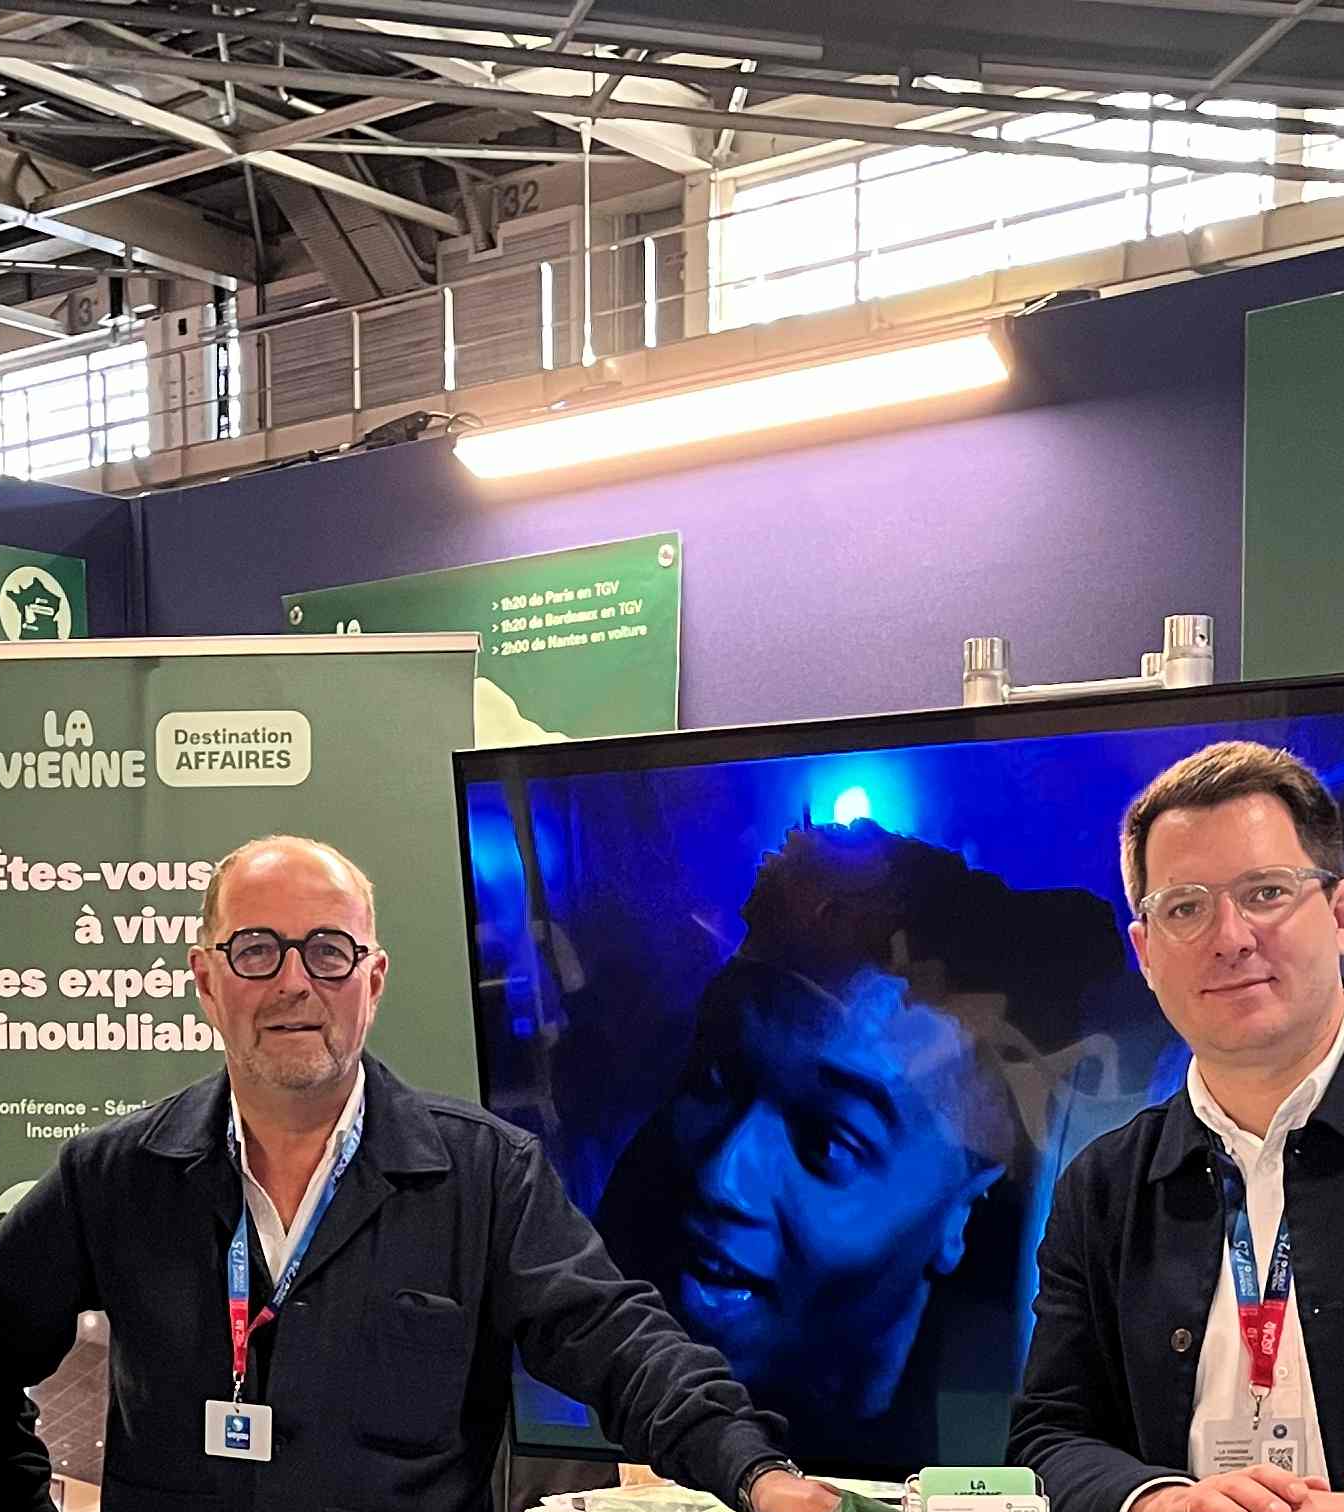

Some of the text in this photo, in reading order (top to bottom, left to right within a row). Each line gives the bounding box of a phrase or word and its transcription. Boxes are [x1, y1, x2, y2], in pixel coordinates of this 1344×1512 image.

[501, 594, 527, 611] 1h20
[529, 591, 544, 607] de
[545, 588, 574, 605] Paris
[577, 587, 592, 600] en
[594, 580, 620, 597] TGV
[501, 617, 527, 634] 1h20
[529, 615, 544, 630] de
[545, 607, 598, 626] Bordeaux
[601, 606, 616, 619] en
[618, 599, 643, 616] TGV
[531, 636, 546, 652] de
[548, 632, 588, 650] Nantes
[591, 630, 605, 643] en
[608, 623, 648, 641] voiture
[43, 710, 93, 748] LA
[174, 727, 293, 747] Destination
[175, 749, 291, 771] AFFAIRES
[75, 905, 204, 945] à vivr
[59, 957, 201, 1009] expér
[970, 1480, 986, 1490] LA
